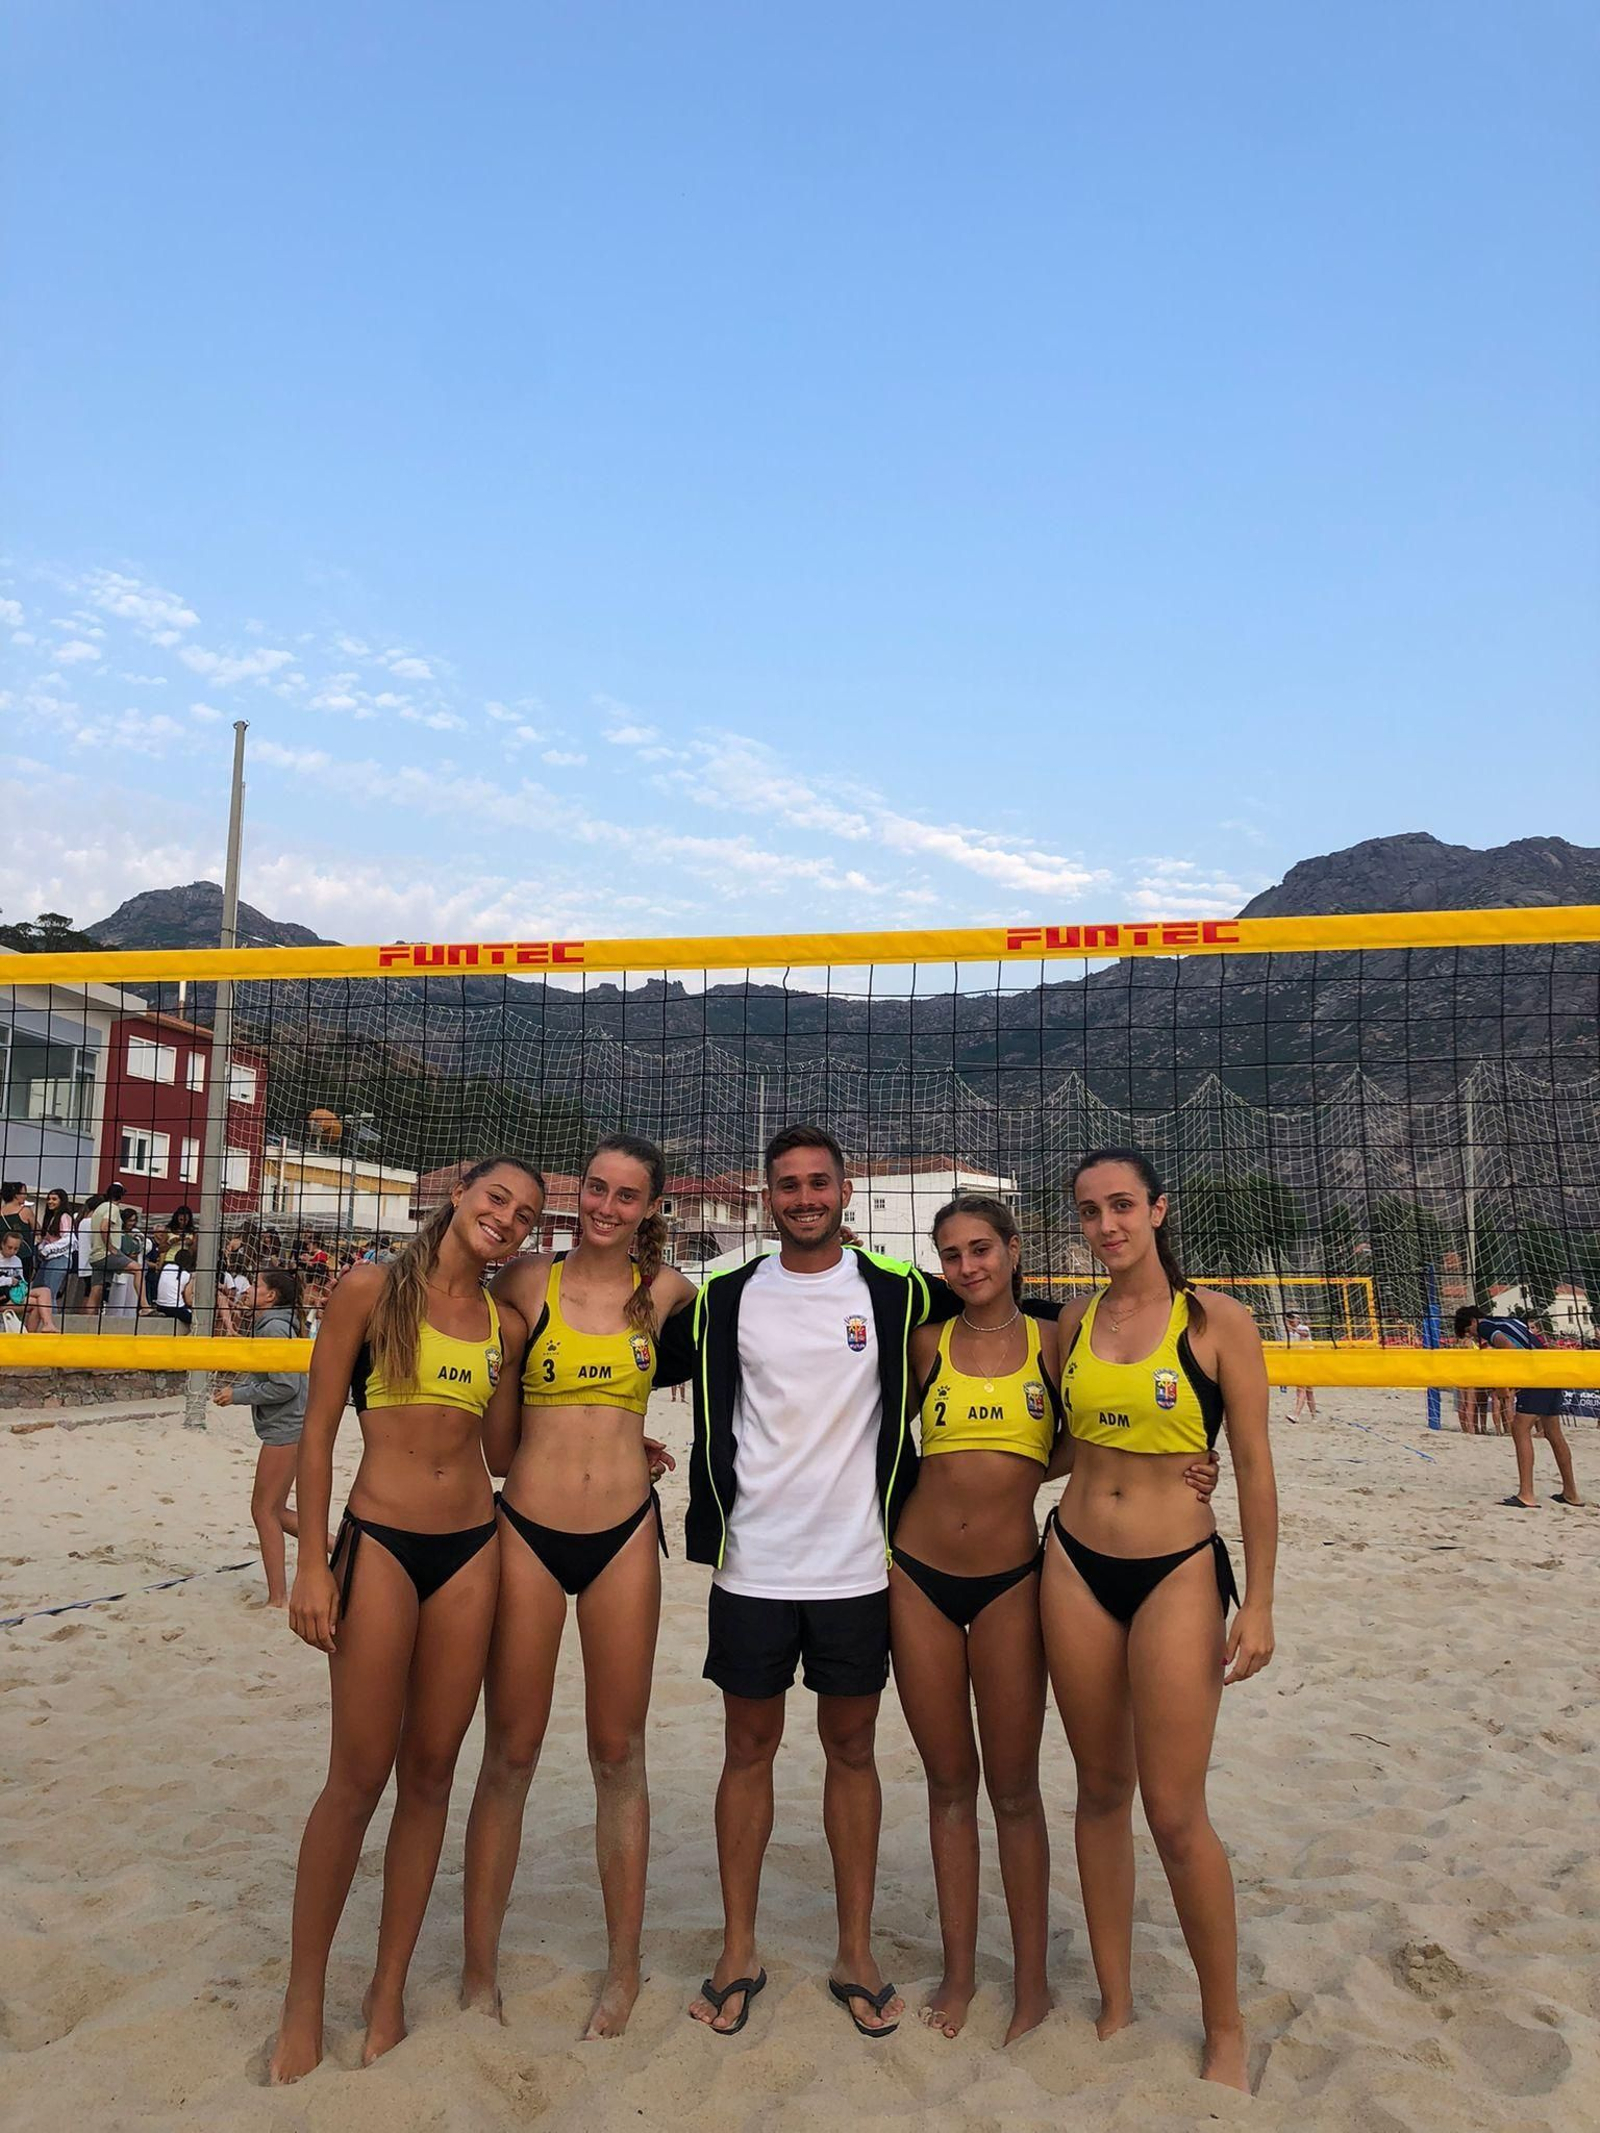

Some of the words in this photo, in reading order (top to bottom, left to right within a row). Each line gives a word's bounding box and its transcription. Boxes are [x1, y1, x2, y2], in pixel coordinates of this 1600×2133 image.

[1007, 921, 1240, 951] FUNTEC
[378, 941, 585, 967] FUNTEC
[437, 1365, 472, 1384] ADM
[542, 1358, 556, 1383] 3
[577, 1365, 612, 1379] ADM
[934, 1401, 947, 1427] 2
[967, 1406, 1004, 1420] ADM
[1099, 1411, 1132, 1428] ADM
